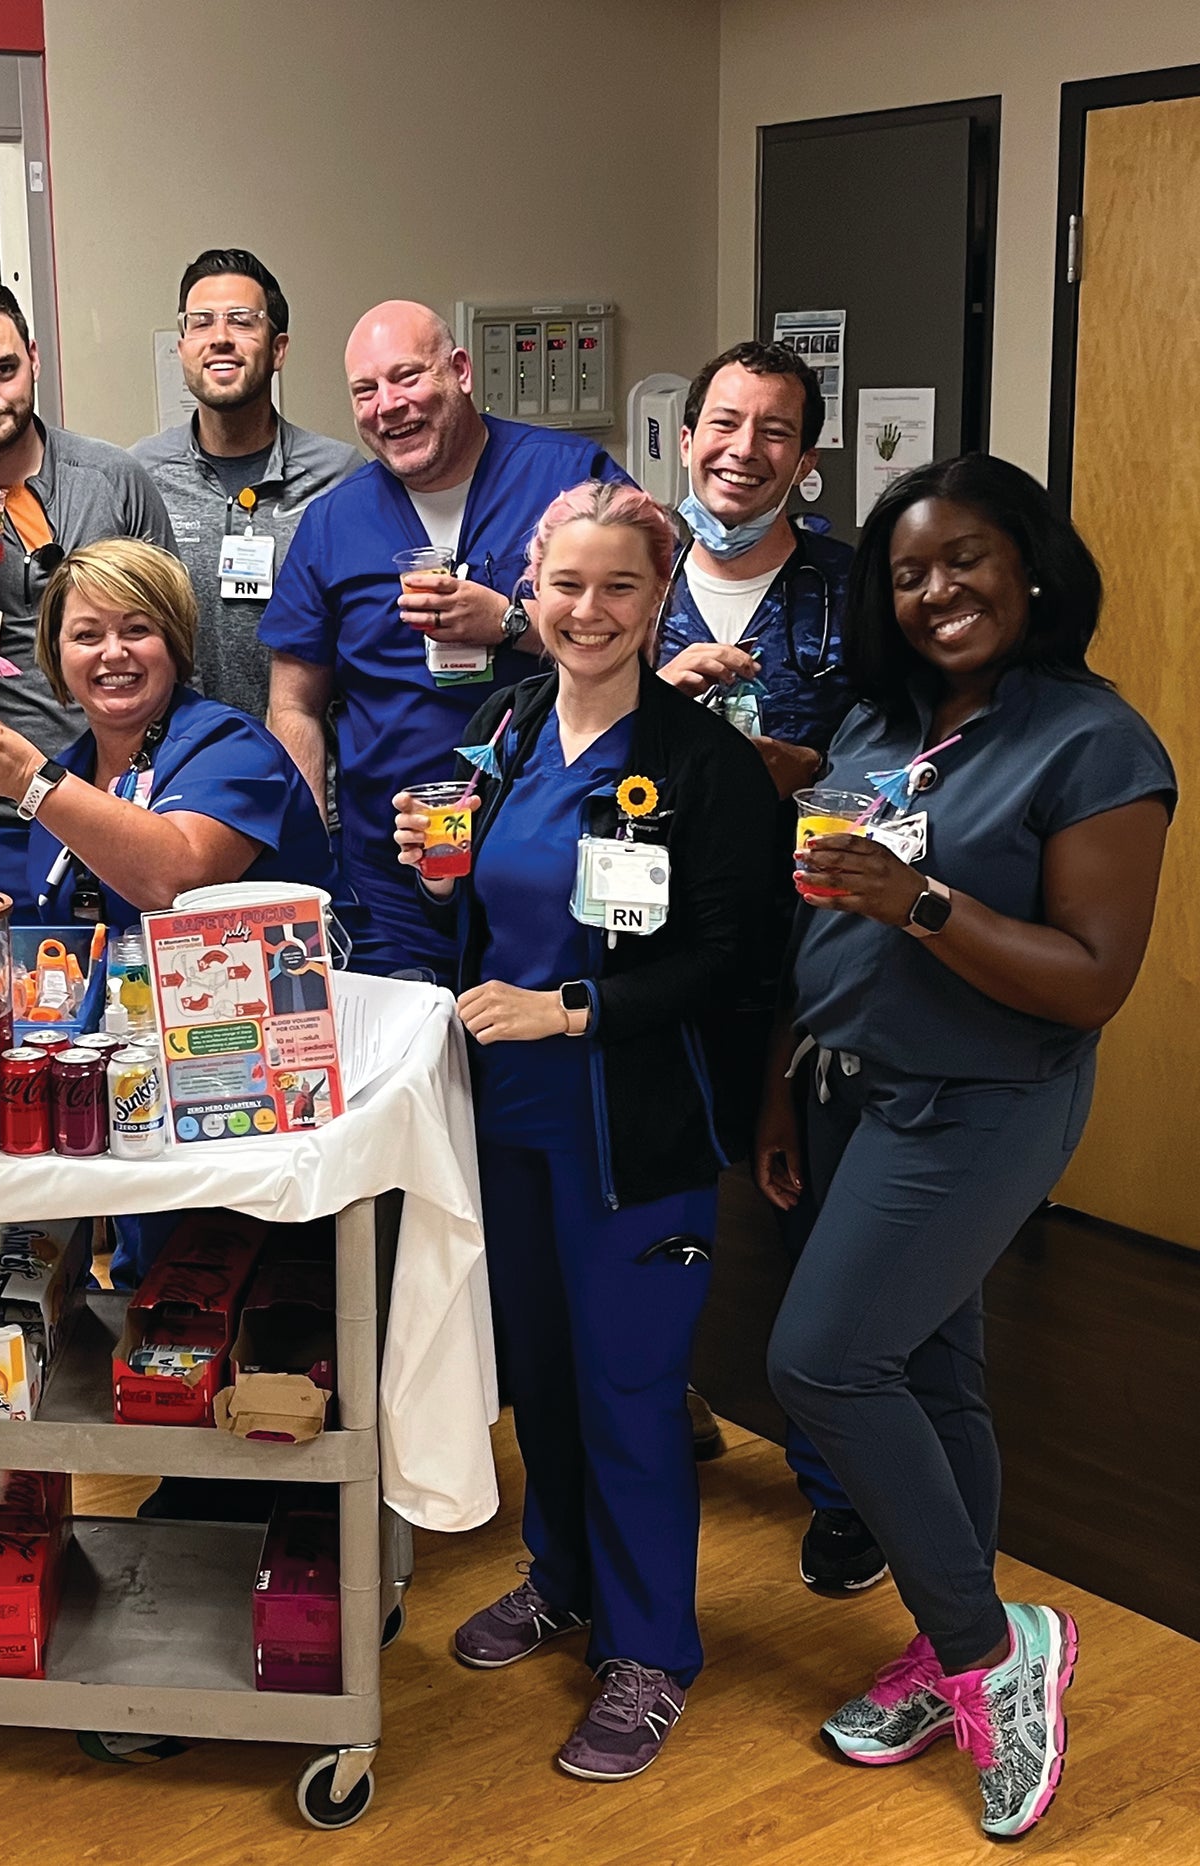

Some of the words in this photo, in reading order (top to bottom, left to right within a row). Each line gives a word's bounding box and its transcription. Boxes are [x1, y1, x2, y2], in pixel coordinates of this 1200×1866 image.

[235, 582, 258, 594] RN
[173, 913, 236, 933] SAFETY
[242, 906, 296, 924] FOCUS
[613, 909, 642, 926] RN
[221, 920, 252, 945] july
[229, 968, 236, 977] 4
[162, 977, 167, 985] 1
[238, 1006, 244, 1015] 5
[115, 1068, 159, 1121] Sunkist
